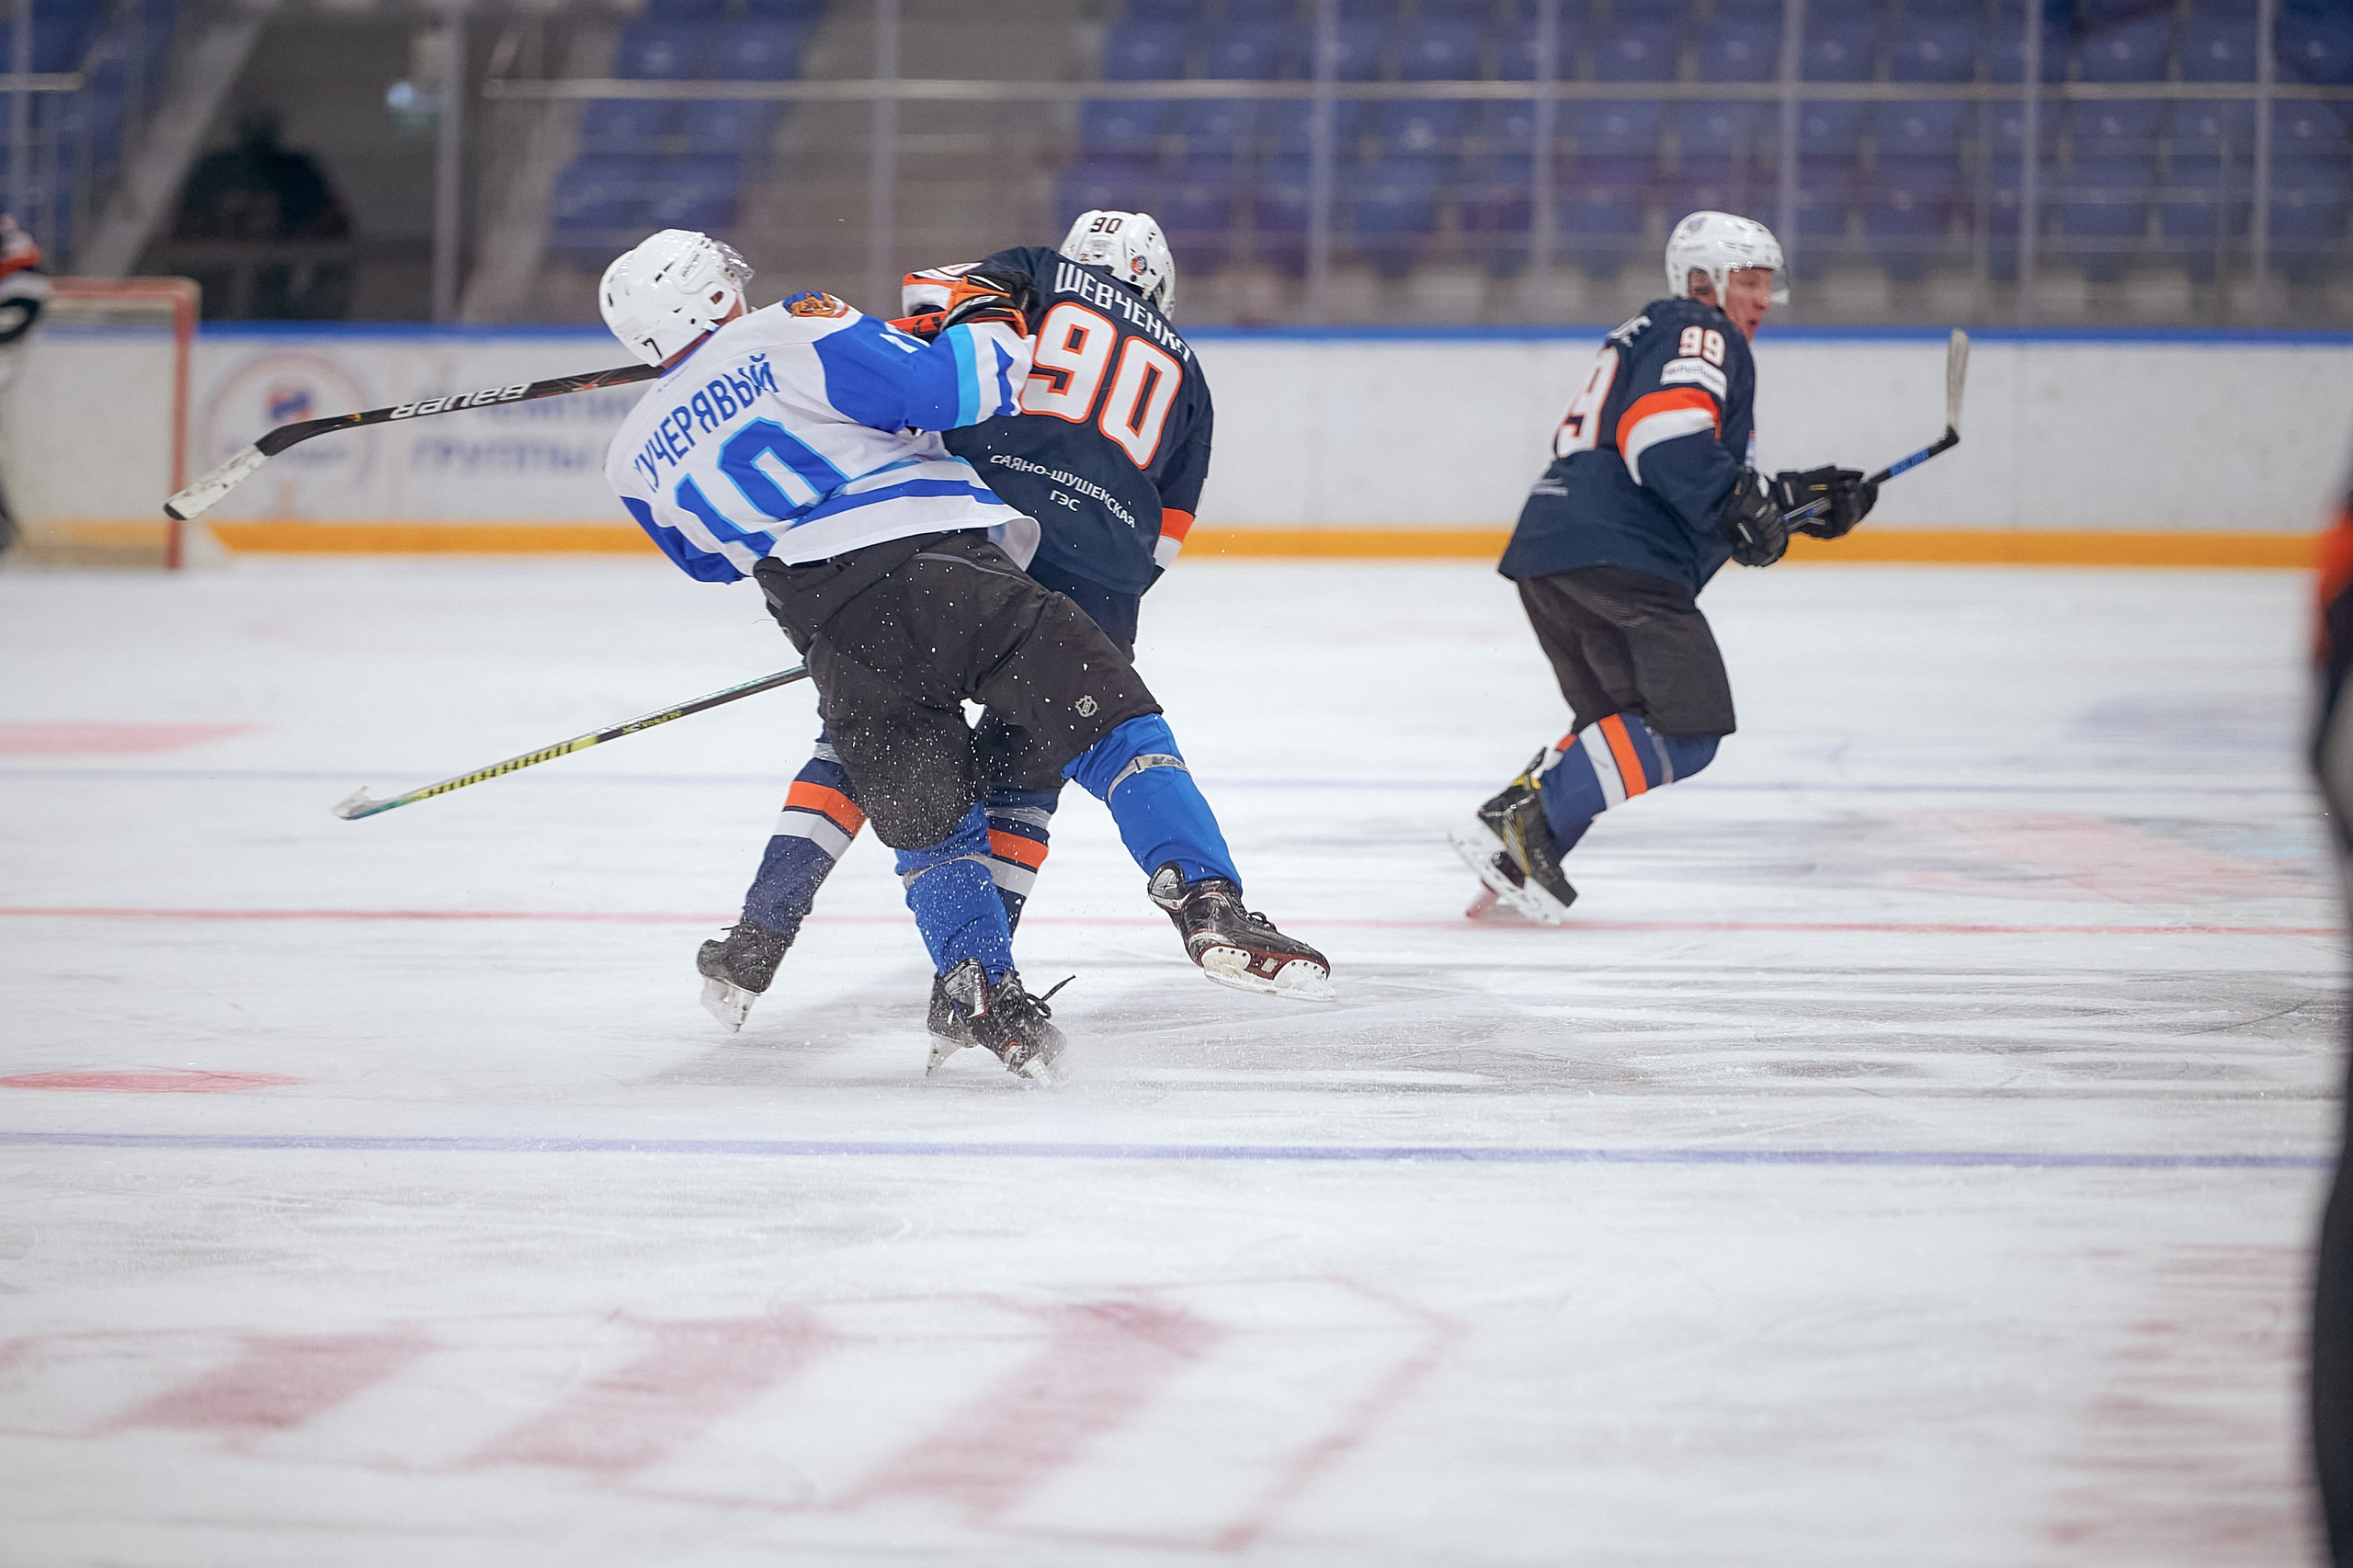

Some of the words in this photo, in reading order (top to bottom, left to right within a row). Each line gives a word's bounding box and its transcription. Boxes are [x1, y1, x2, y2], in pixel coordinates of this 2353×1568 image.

[1089, 216, 1123, 234] 90
[641, 337, 664, 360] 7
[1677, 324, 1726, 368] 99
[1017, 301, 1184, 471] 90
[674, 416, 852, 560] 10
[990, 454, 1136, 529] САЯНО-ШУШЕНСКАЯ
[1050, 489, 1082, 513] ГЭС
